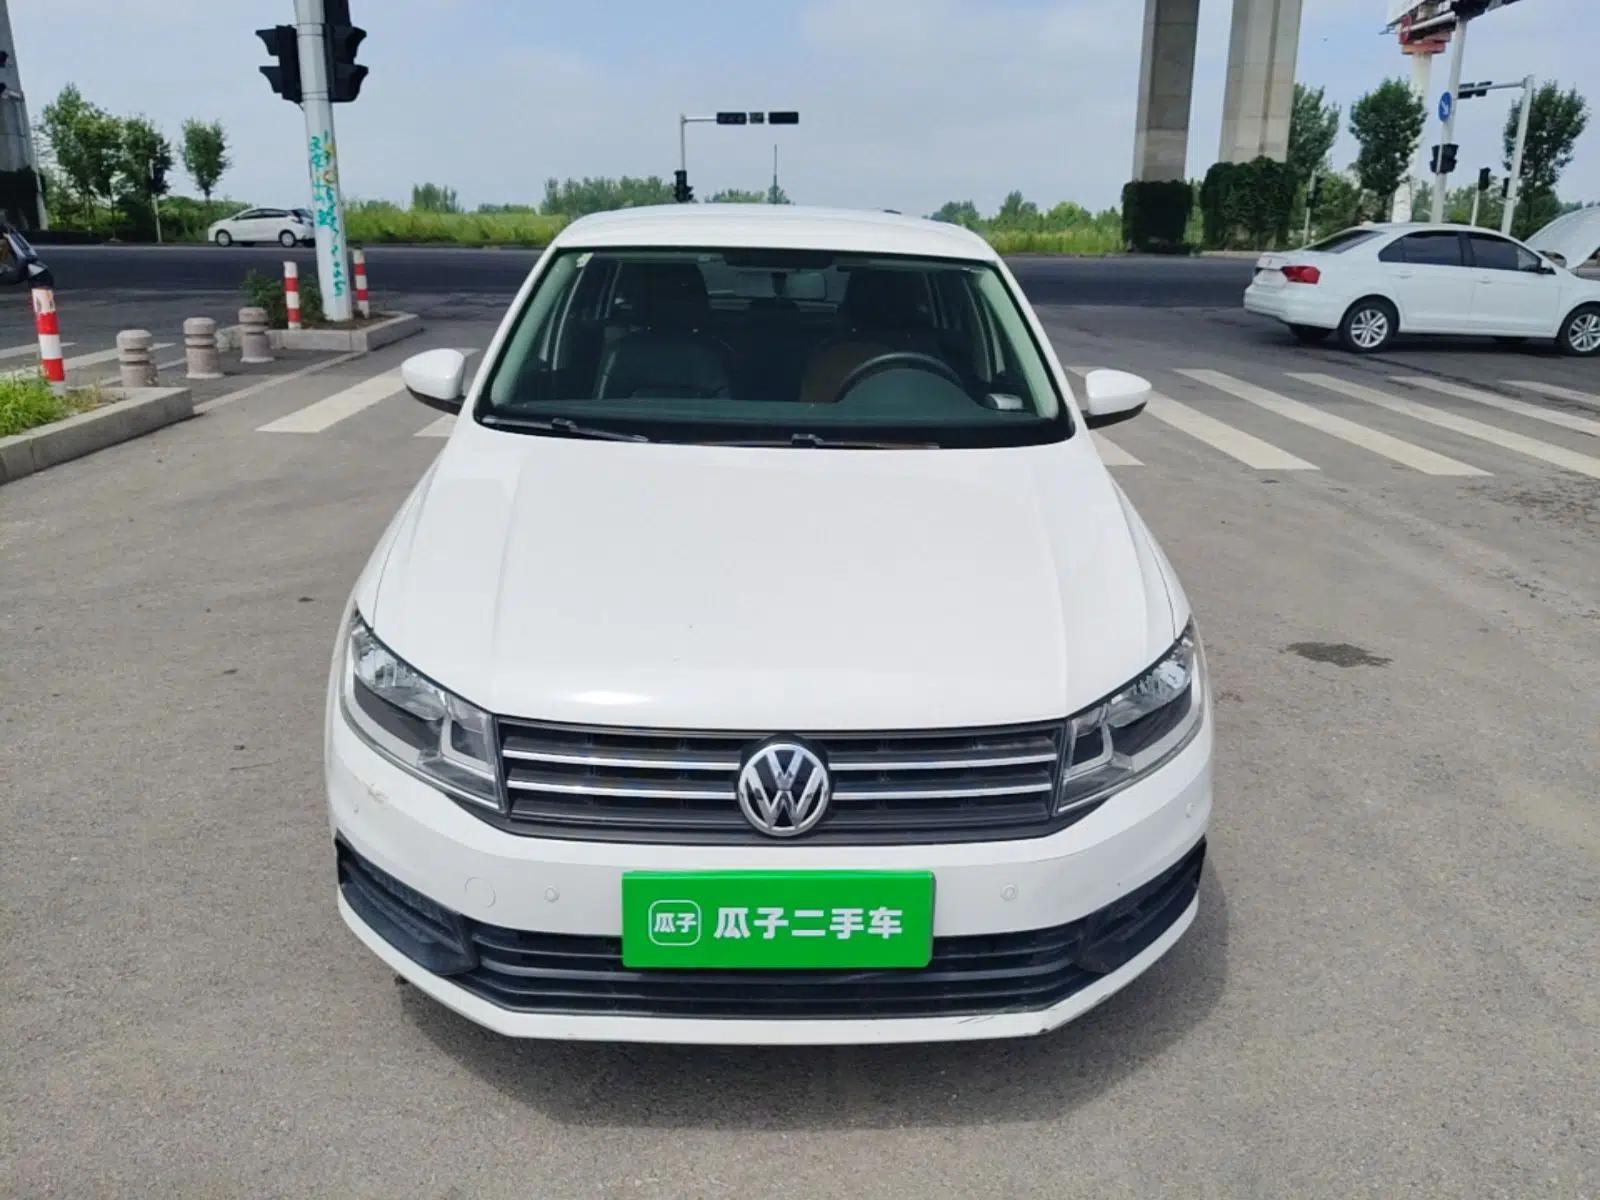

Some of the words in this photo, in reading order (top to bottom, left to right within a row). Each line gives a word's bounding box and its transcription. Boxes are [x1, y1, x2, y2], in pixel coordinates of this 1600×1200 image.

[654, 913, 696, 932] 瓜子
[714, 907, 902, 939] 瓜子二手车
